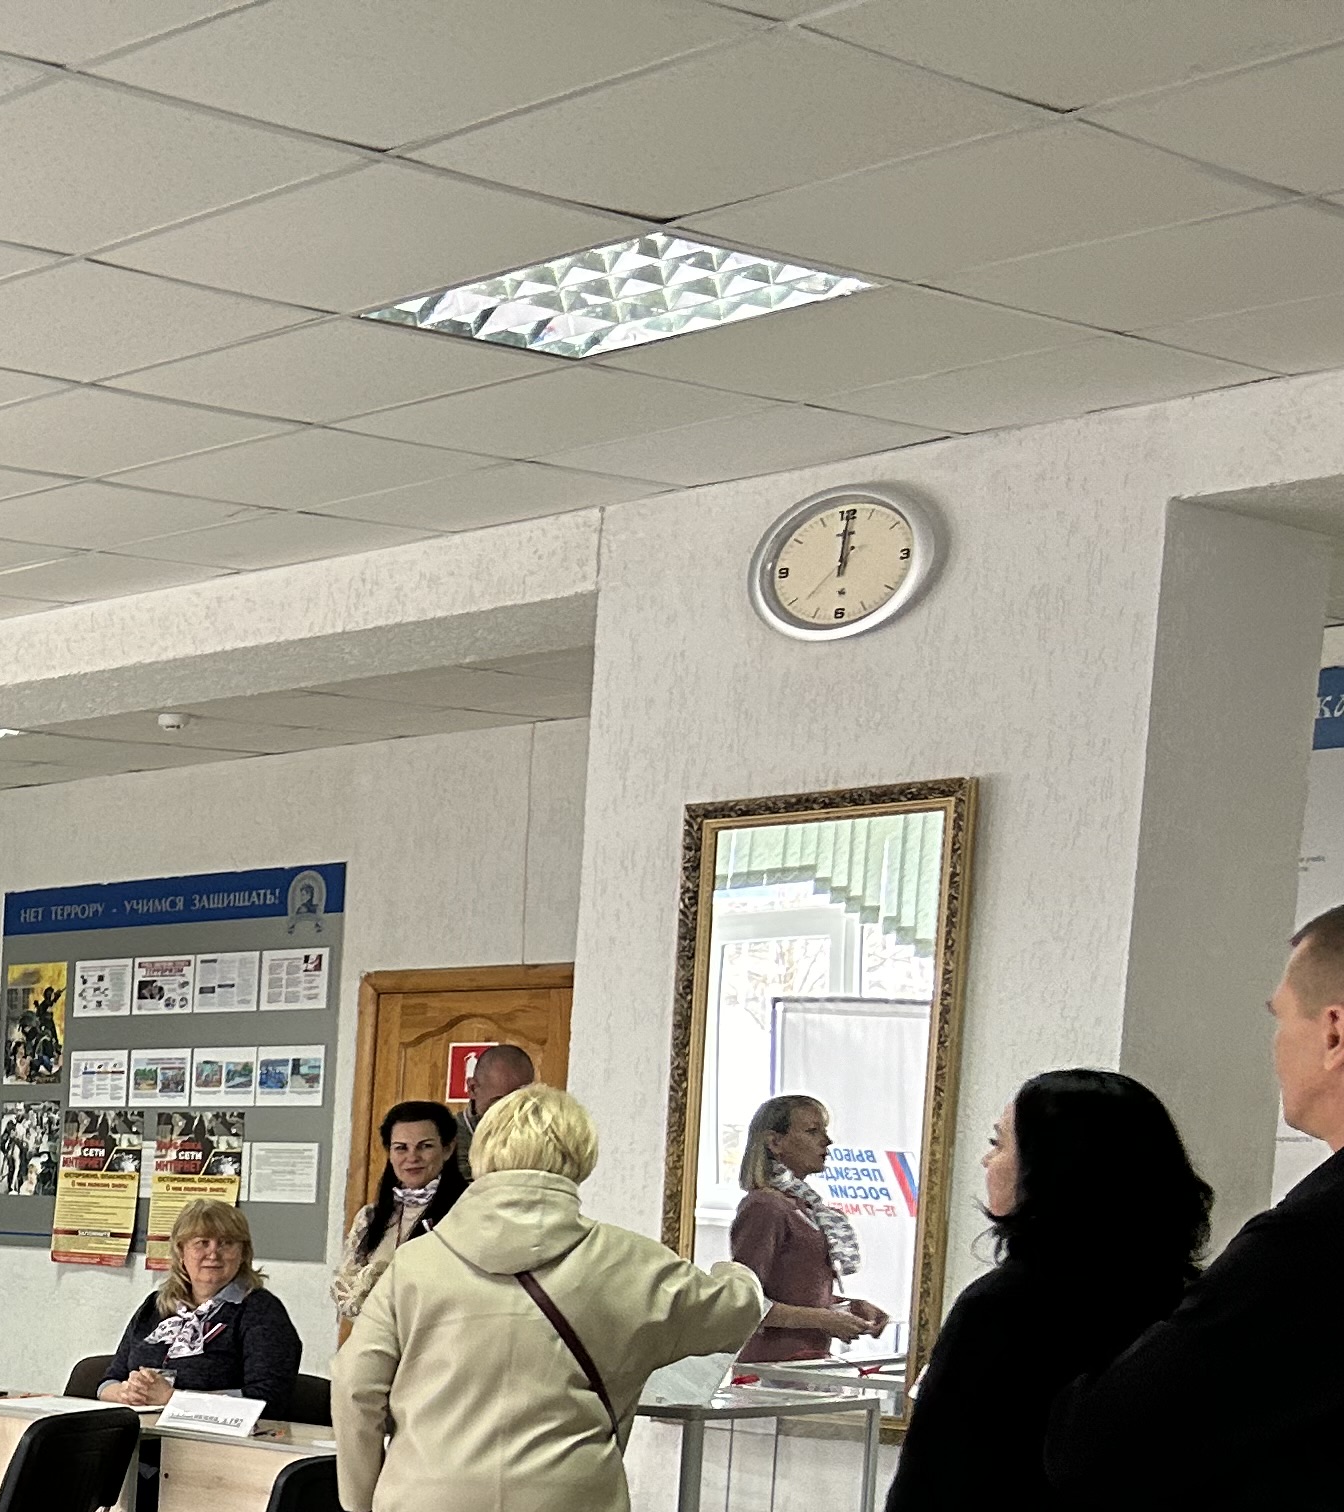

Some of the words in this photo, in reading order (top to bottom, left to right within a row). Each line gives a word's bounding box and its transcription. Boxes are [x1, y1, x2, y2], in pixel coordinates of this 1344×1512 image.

[838, 509, 858, 521] 12
[900, 548, 911, 560] 3
[778, 567, 789, 579] 9
[834, 608, 845, 619] 6
[20, 907, 44, 923] НЕТ
[51, 902, 105, 921] ТЕРРОРУ
[124, 896, 185, 915] УЧИМСЯ
